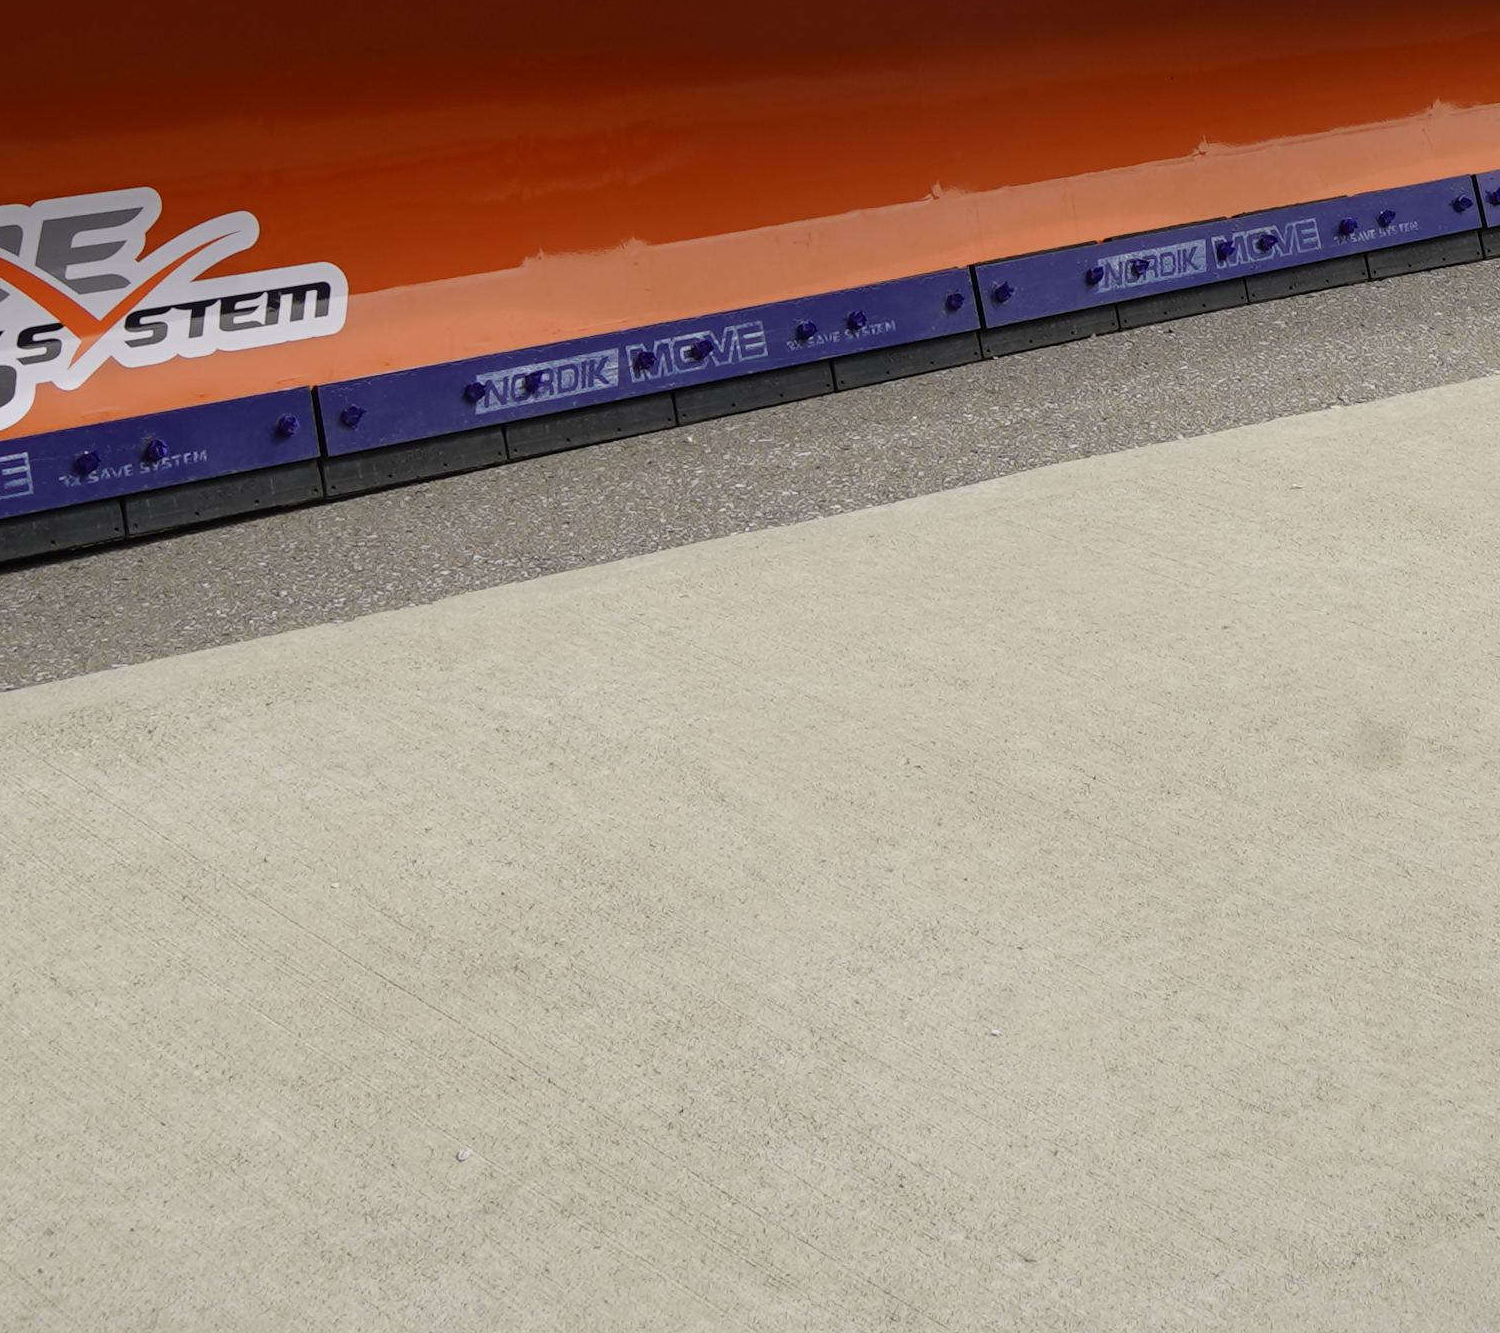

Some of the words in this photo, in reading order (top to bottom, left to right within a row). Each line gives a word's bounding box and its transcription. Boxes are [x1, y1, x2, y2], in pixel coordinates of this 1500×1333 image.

[1212, 218, 1322, 269] MOVE
[625, 320, 768, 383] MOVE
[807, 330, 841, 350] SAVE
[87, 463, 135, 484] SAVE
[139, 449, 208, 474] SYSTEM
